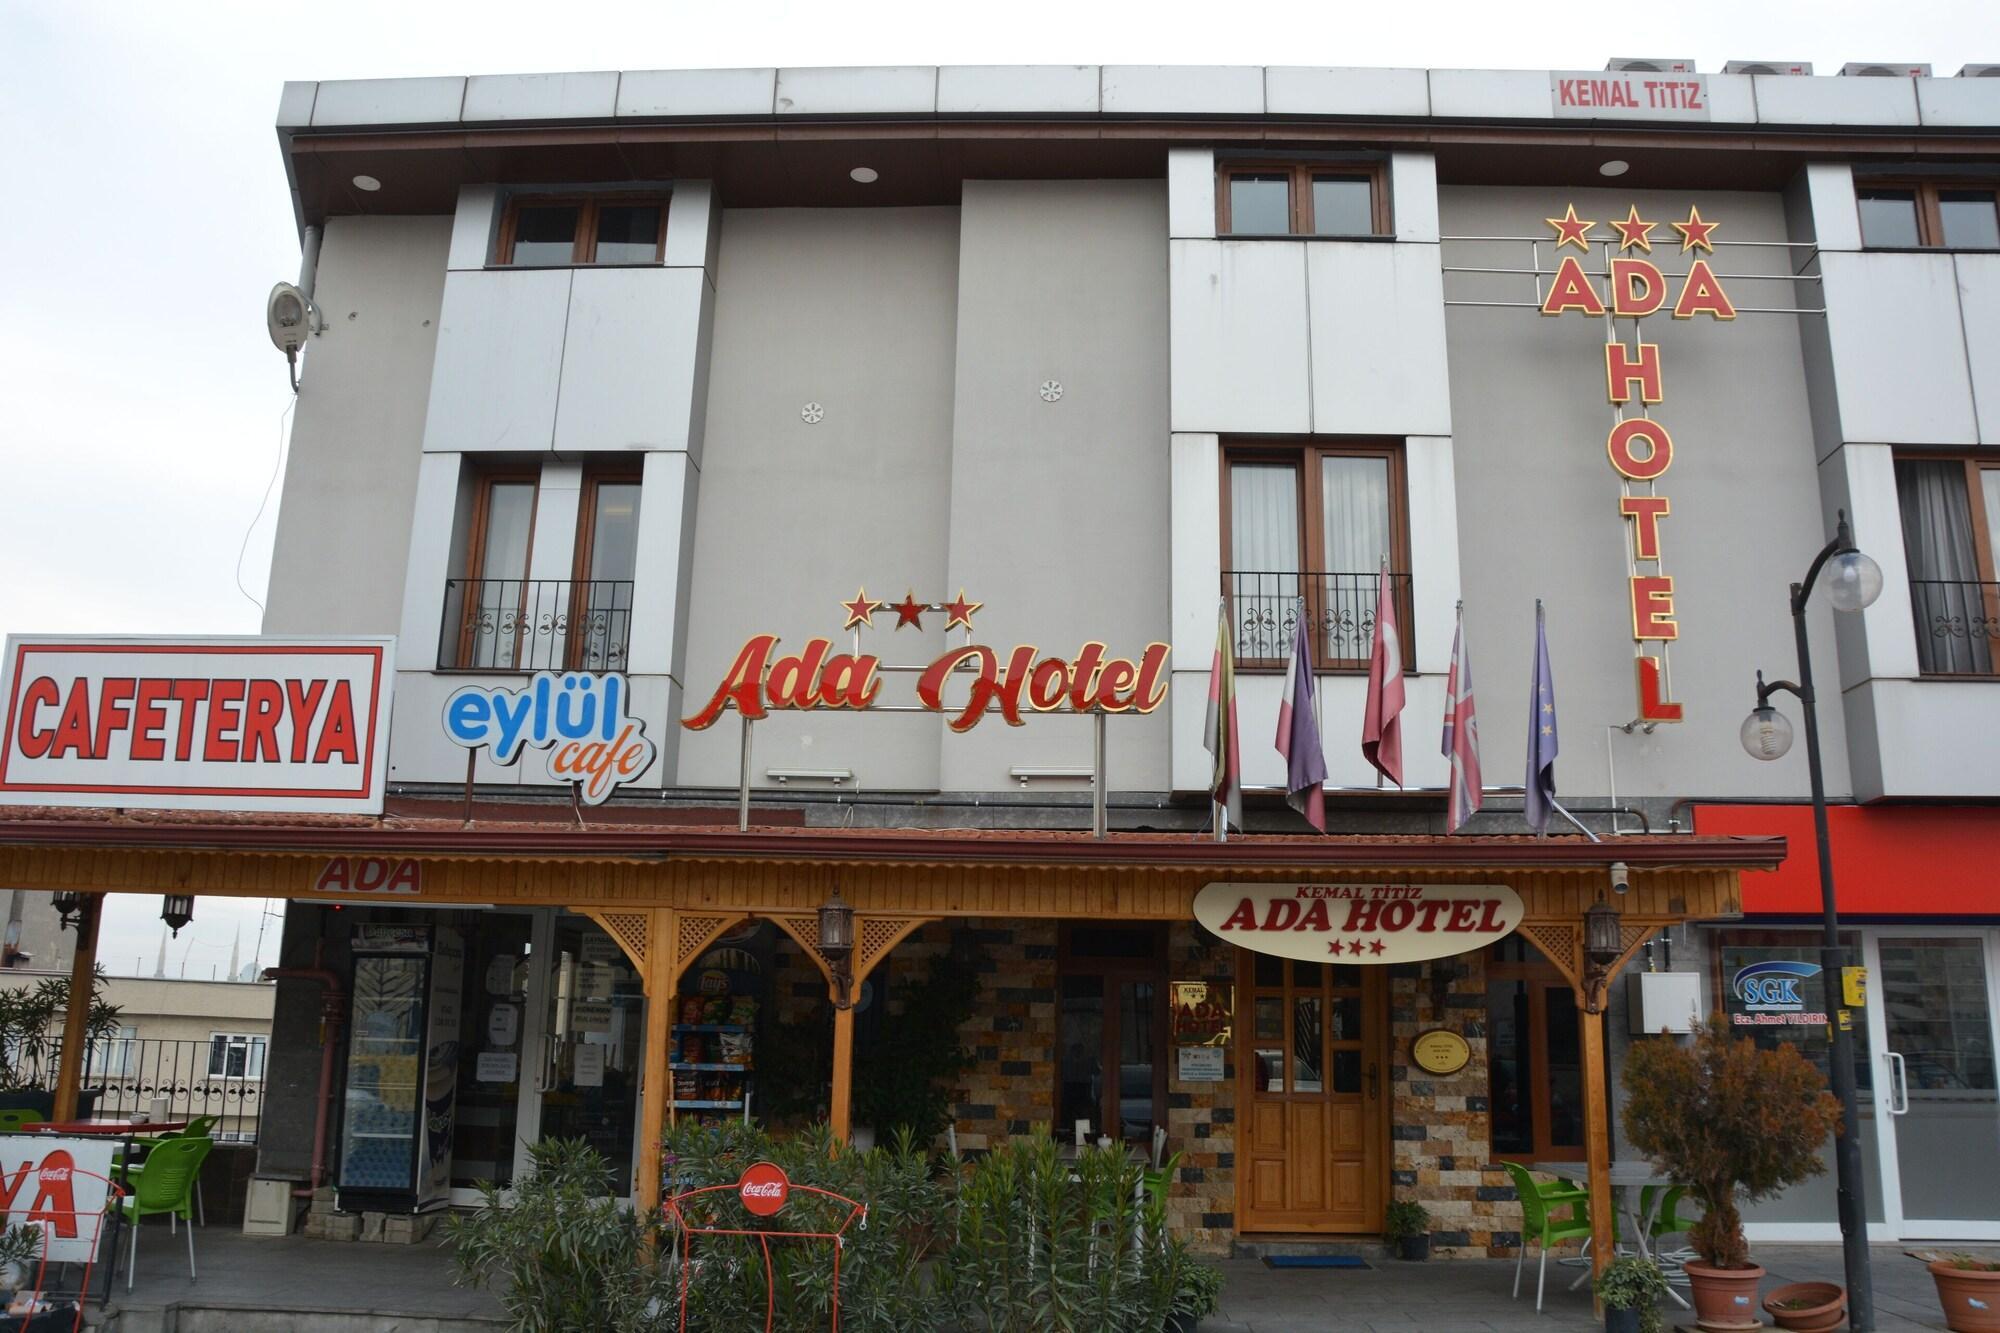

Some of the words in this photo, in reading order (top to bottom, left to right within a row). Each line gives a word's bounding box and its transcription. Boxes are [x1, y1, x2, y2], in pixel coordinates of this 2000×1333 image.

[1559, 79, 1640, 108] KEMAL
[1540, 256, 1737, 320] ADA
[1605, 342, 1684, 723] HOTEL
[681, 634, 883, 731] Ada
[915, 640, 1171, 733] Hotel
[18, 675, 359, 765] CAFETERYA
[449, 676, 619, 759] eylül
[554, 724, 644, 798] cafe
[316, 856, 421, 892] ADA
[1296, 886, 1365, 899] KEMAL
[1219, 897, 1332, 932] ADA
[1341, 898, 1507, 933] HOTEL
[1743, 978, 1803, 1004] SGK
[1755, 1012, 1786, 1025] Ahmet
